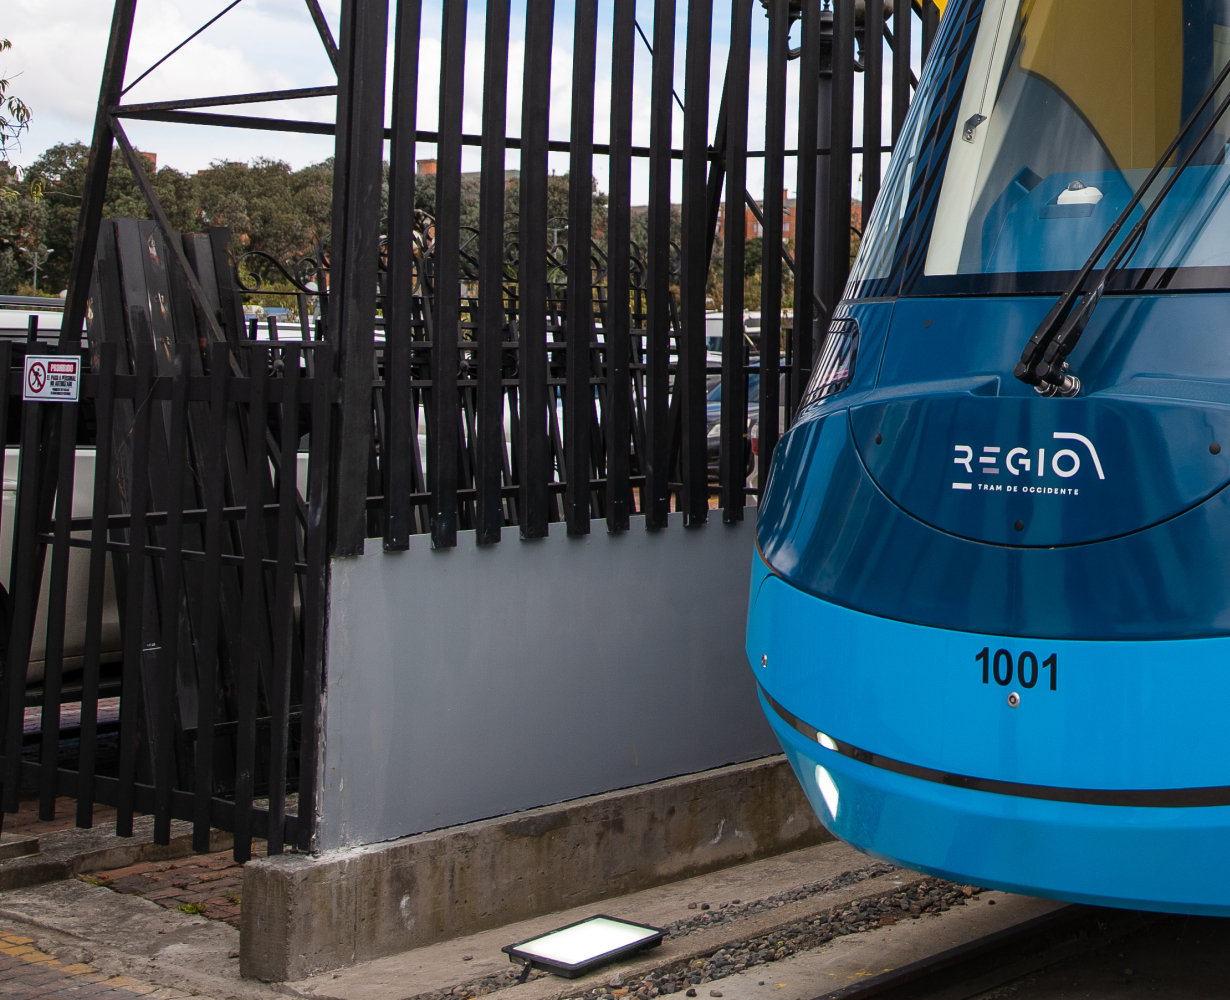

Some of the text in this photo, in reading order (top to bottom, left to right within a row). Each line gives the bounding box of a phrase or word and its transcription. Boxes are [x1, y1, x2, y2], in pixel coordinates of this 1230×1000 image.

[953, 445, 1081, 478] REGIO
[977, 483, 1080, 496] TRAM DE OCCIDENTE
[974, 646, 1058, 692] 1001
